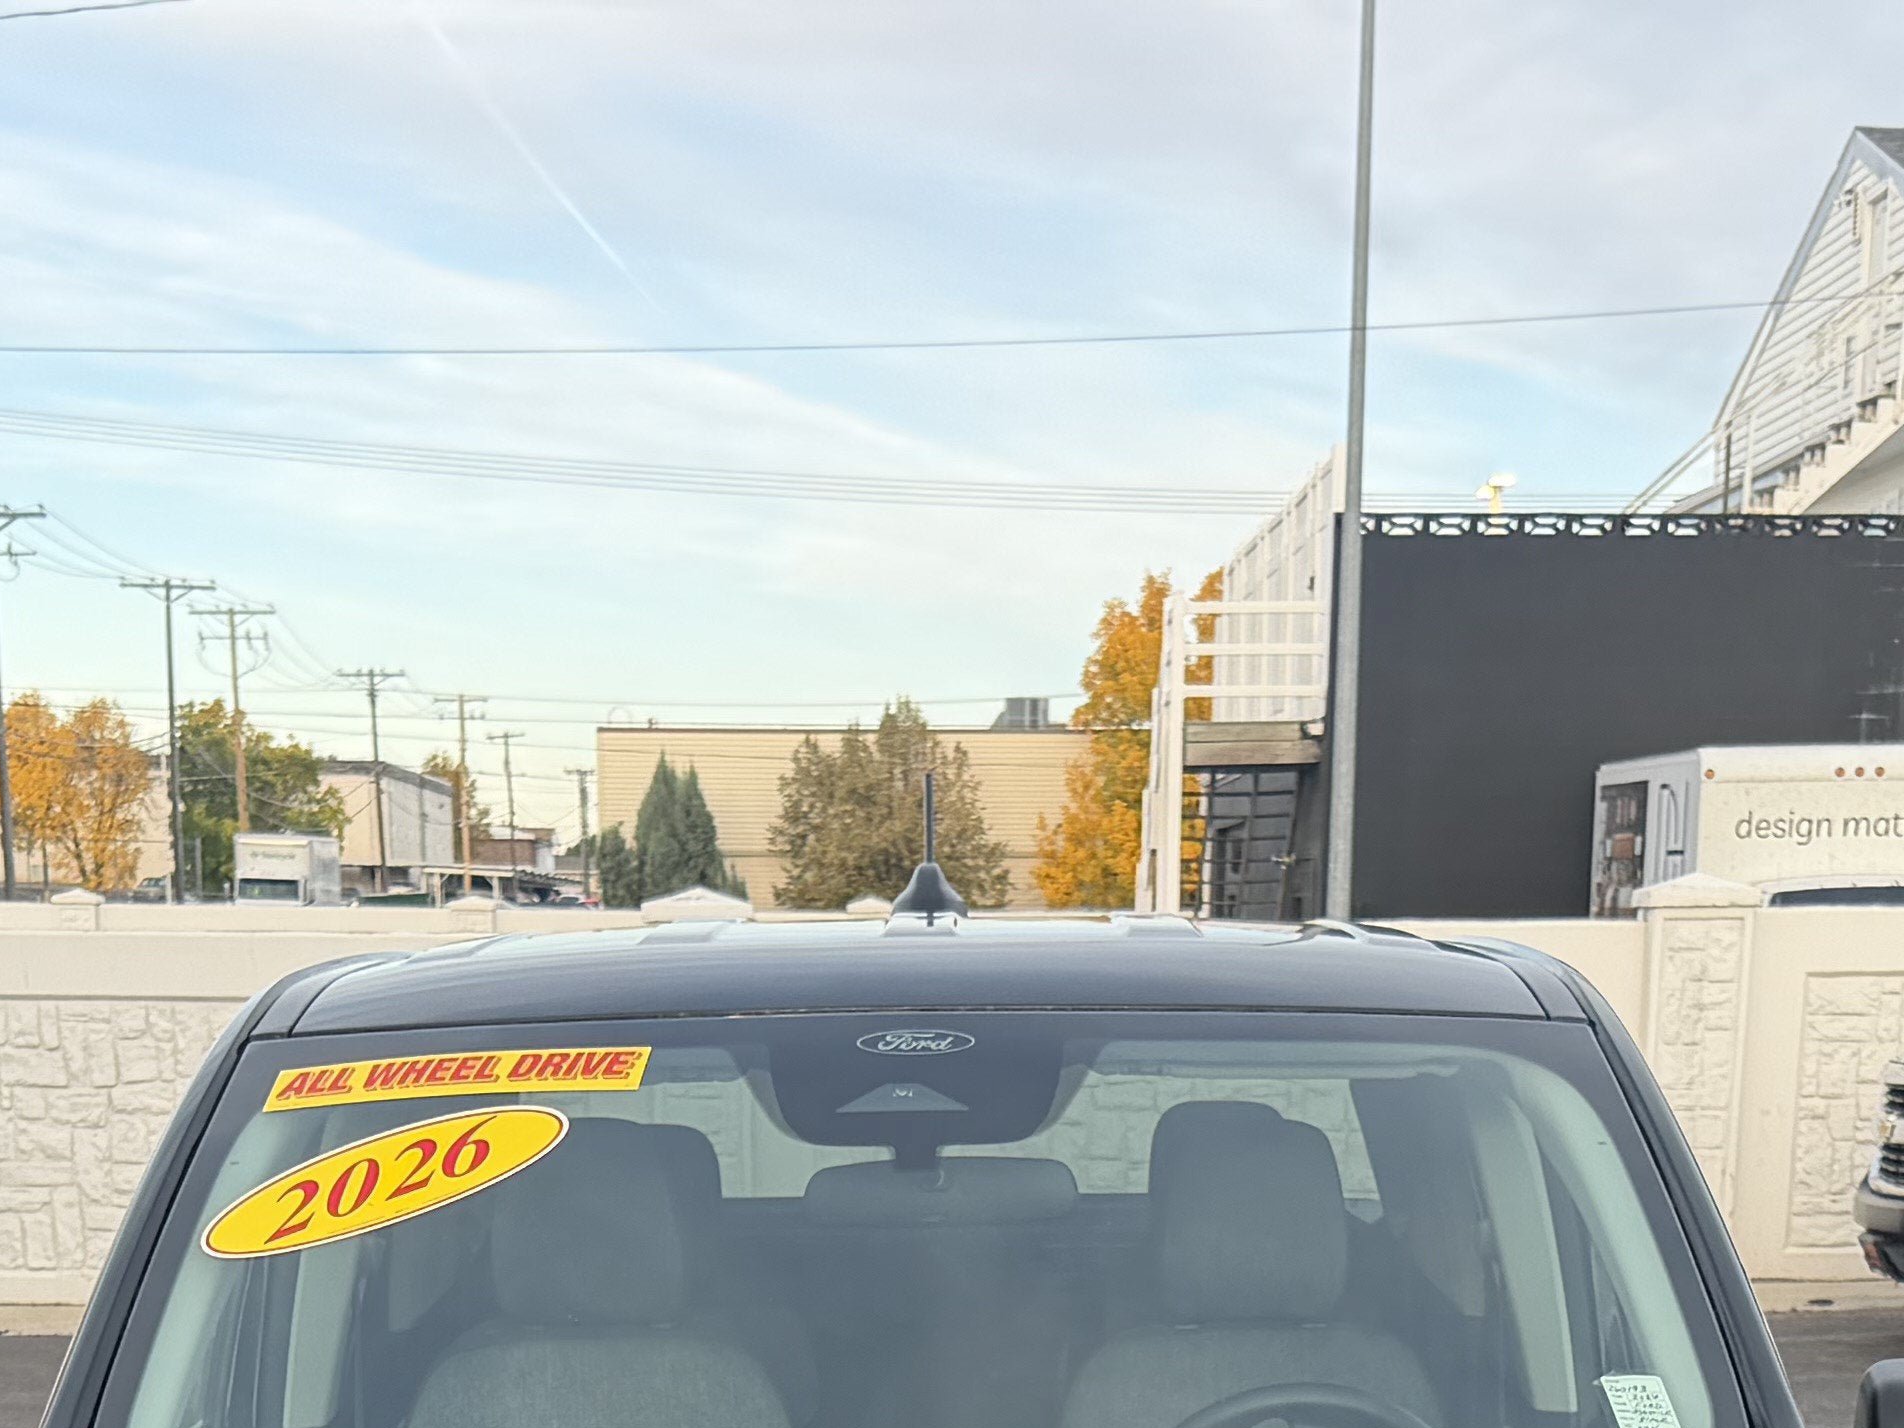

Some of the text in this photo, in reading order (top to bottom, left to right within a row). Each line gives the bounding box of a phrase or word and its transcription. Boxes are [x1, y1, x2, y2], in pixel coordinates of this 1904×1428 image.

[1735, 811, 1833, 846] design
[877, 1033, 955, 1052] Ford
[276, 1046, 642, 1100] ALL WHEEL DRIVE
[263, 1115, 498, 1245] 2026
